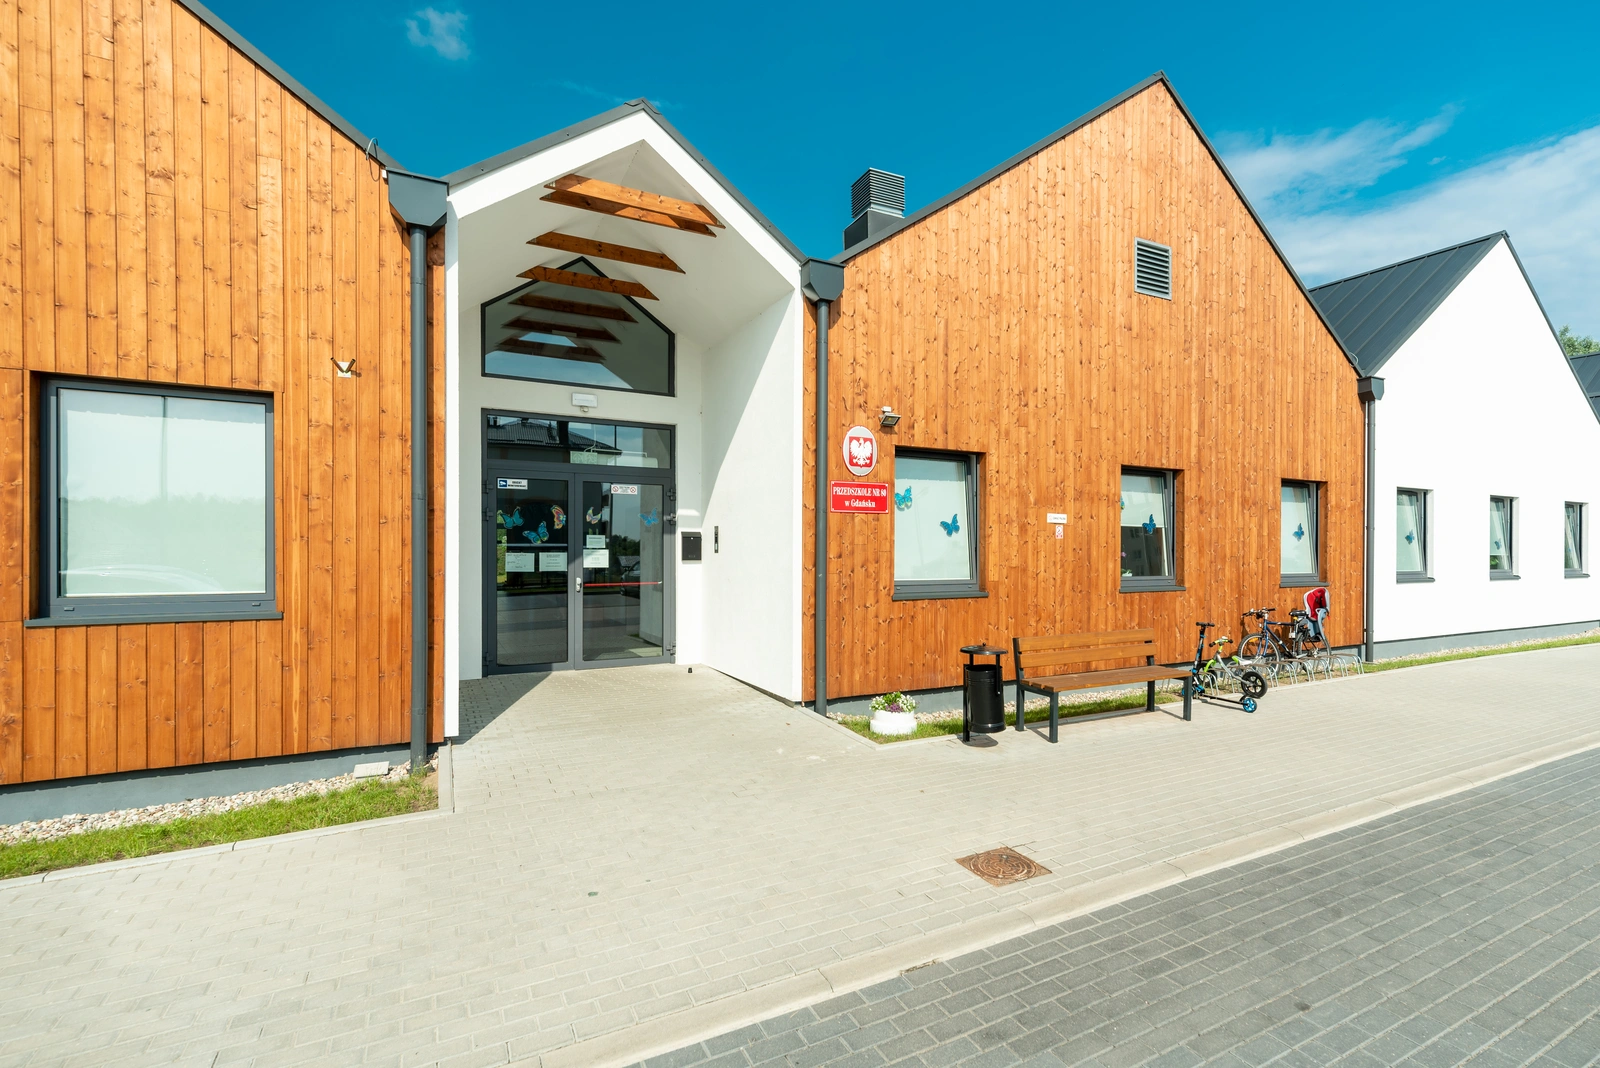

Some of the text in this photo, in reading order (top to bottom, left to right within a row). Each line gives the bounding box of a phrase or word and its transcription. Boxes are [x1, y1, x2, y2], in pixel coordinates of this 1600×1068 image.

[833, 486, 872, 496] PRZEDSZKOLE
[872, 488, 880, 496] NR
[851, 499, 876, 507] Gdańsku
